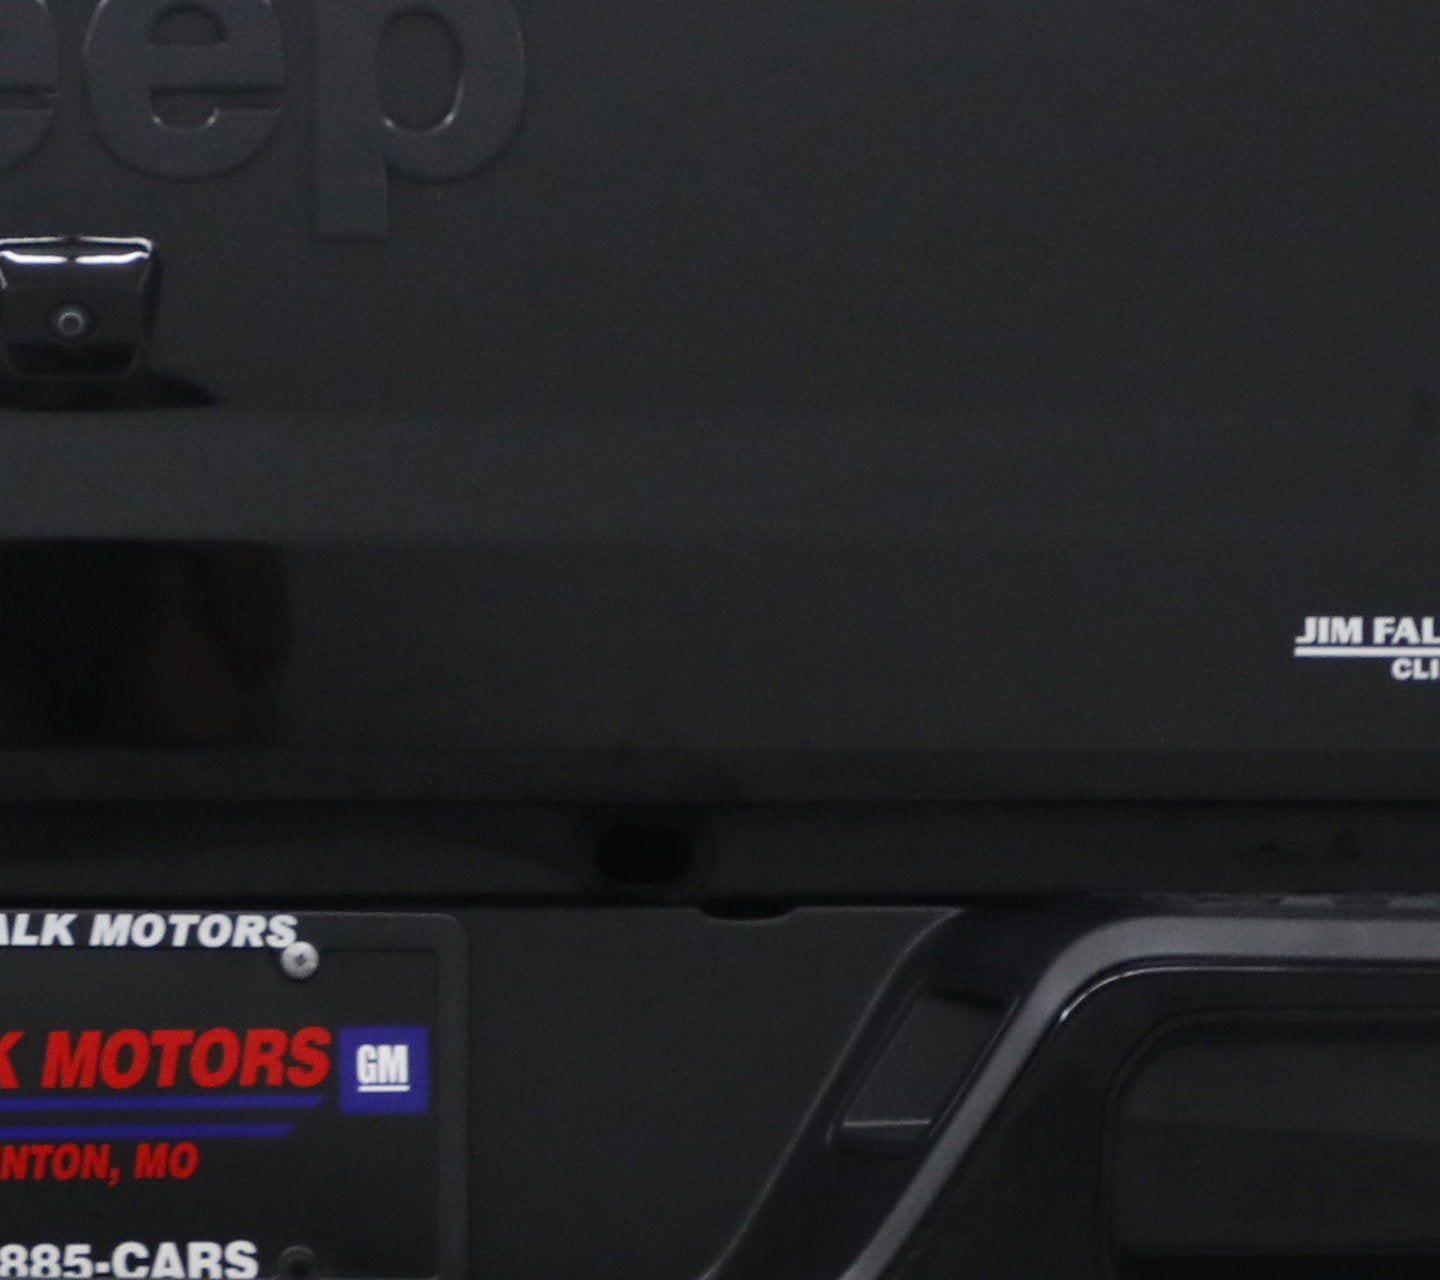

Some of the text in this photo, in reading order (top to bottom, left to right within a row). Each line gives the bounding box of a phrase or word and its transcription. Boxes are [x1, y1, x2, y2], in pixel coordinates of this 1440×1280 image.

[1294, 616, 1364, 645] JIM
[89, 913, 298, 948] MOTORS
[41, 1027, 332, 1089] MOTORS
[355, 1044, 409, 1084] GM
[133, 1142, 199, 1180] MO
